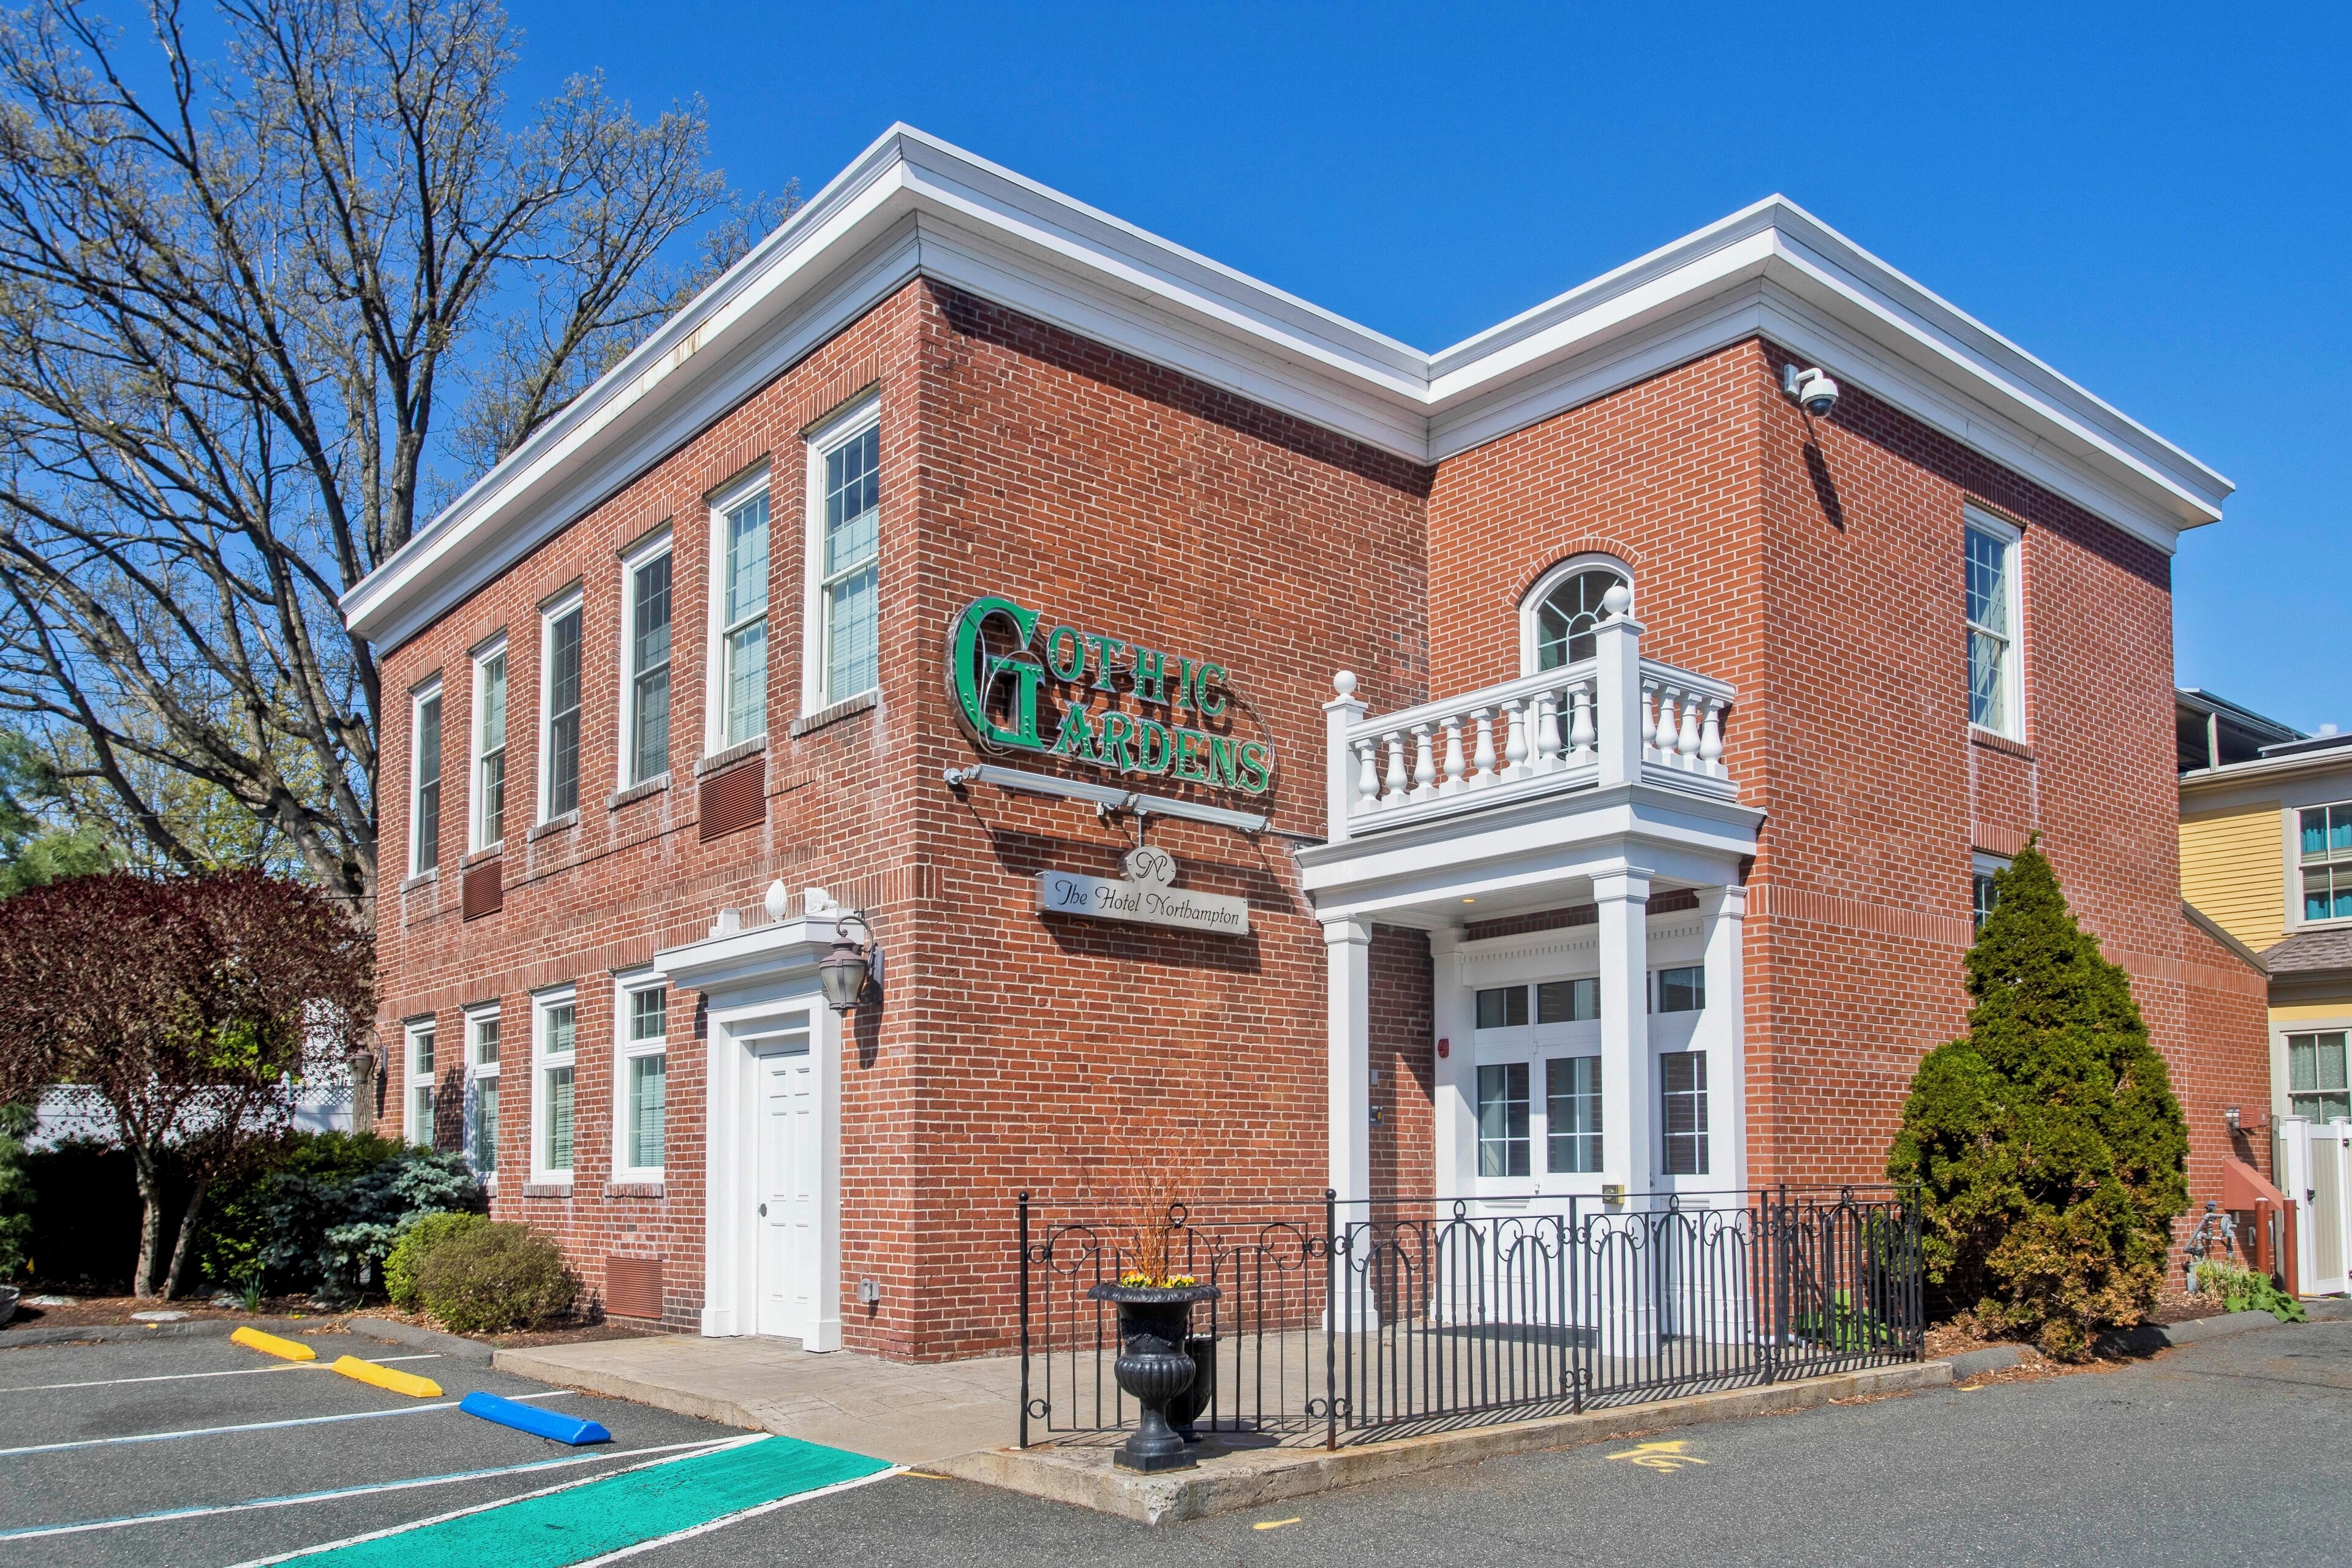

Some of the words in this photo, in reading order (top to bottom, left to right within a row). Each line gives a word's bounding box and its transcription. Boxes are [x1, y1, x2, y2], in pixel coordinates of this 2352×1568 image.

[1055, 880, 1088, 905] The
[1095, 886, 1142, 912] Hotel
[1146, 893, 1239, 927] Northampton
